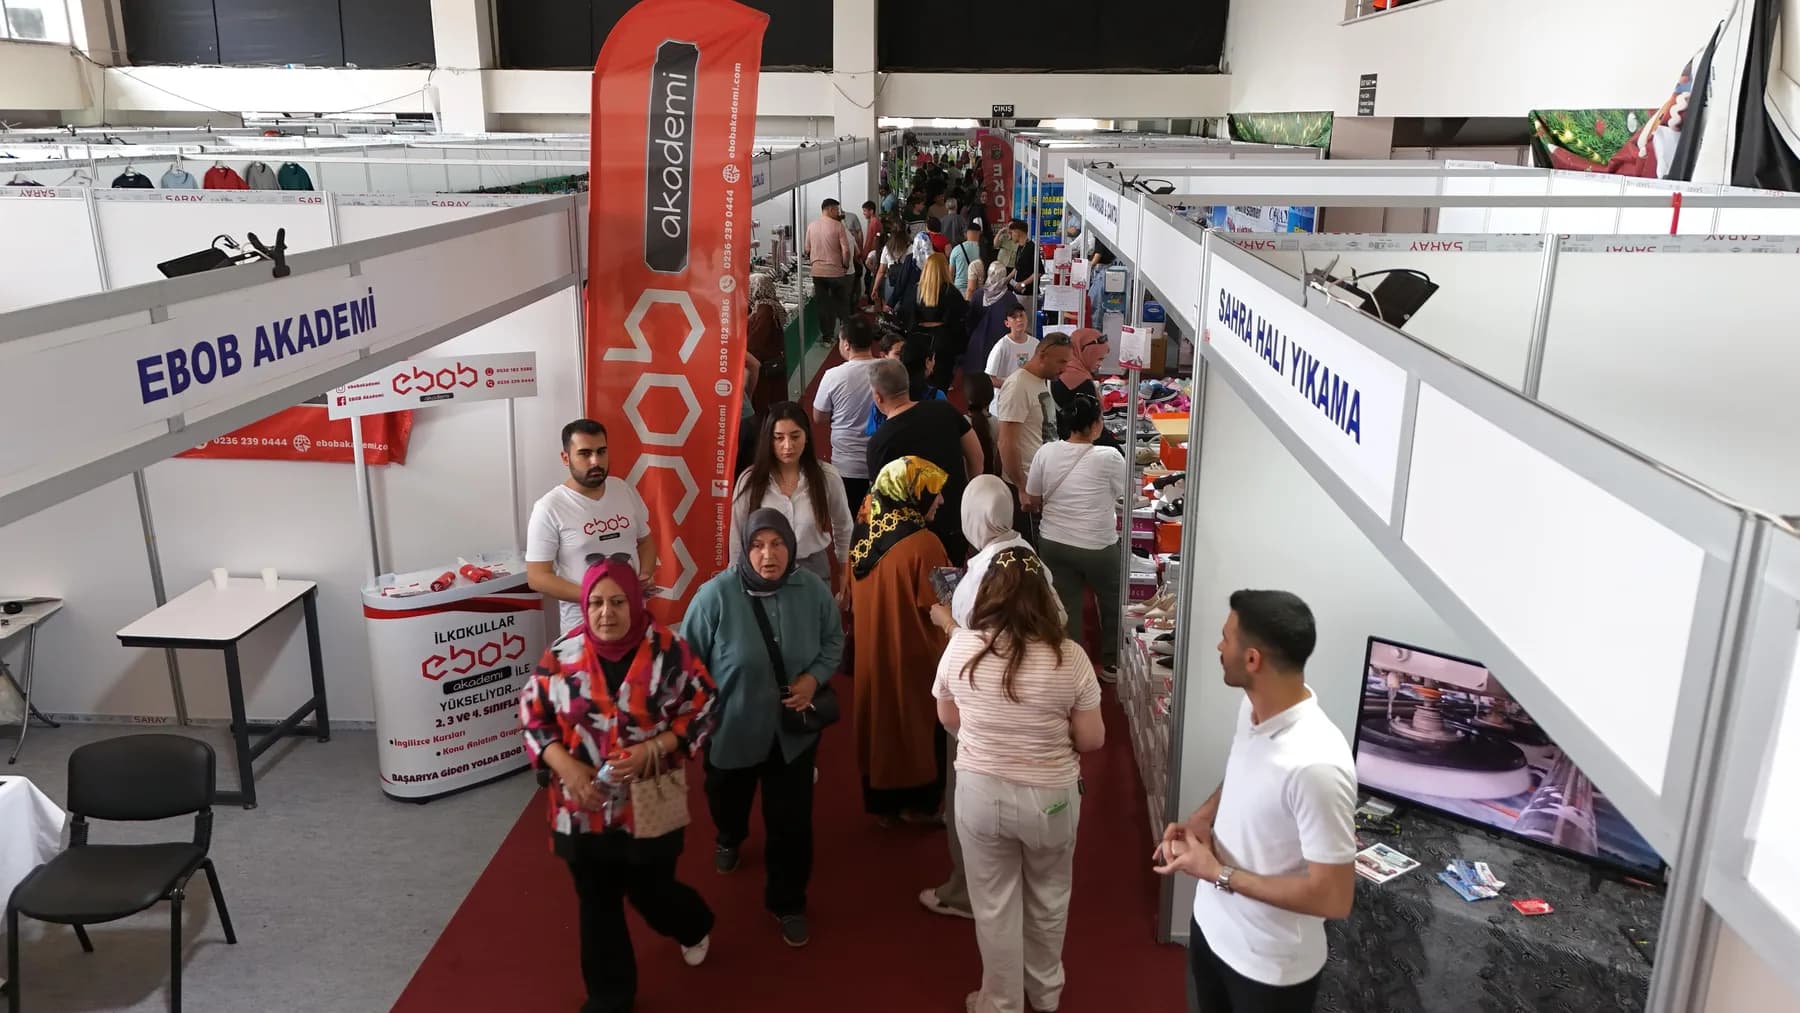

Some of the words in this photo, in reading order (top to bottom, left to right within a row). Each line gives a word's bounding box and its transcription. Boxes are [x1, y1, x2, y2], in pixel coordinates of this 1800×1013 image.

[728, 63, 741, 159] ebobakademi.com
[652, 72, 688, 239] akademi
[19, 189, 56, 198] SARAY
[725, 189, 734, 218] 0444
[724, 220, 733, 240] 239
[723, 243, 732, 269] 0236
[1409, 241, 1463, 252] SARAY
[136, 333, 242, 405] EBOB
[253, 286, 377, 367] AKADEMİ
[720, 327, 729, 345] 182
[719, 348, 728, 373] 0530
[1218, 287, 1253, 348] SAHRA
[1255, 315, 1287, 376] HALI
[1291, 341, 1361, 445] YIKAMA
[391, 361, 478, 395] ebob
[717, 404, 727, 446] Akademi
[213, 437, 238, 445] 0236
[240, 437, 259, 446] 239
[261, 438, 287, 446] 0444
[315, 440, 389, 450] ebobakemi.co
[716, 449, 725, 474] EBOB
[583, 514, 630, 536] ebob
[715, 503, 724, 567] ebobakademi
[434, 615, 515, 644] İLKOKULLAR
[421, 631, 526, 681] ebob
[452, 670, 504, 692] akademi
[515, 663, 530, 677] İLE
[440, 684, 521, 712] YÜKSELİYOR...
[435, 719, 446, 728] 2.
[447, 716, 455, 726] 3
[472, 709, 482, 719] 4.
[483, 697, 520, 716] SINIFLA
[394, 738, 430, 748] İngilizce
[442, 745, 464, 755] Konu
[391, 771, 439, 784] BAŞARIYA
[471, 754, 499, 770] YOLDA
[500, 746, 522, 760] EBOB
